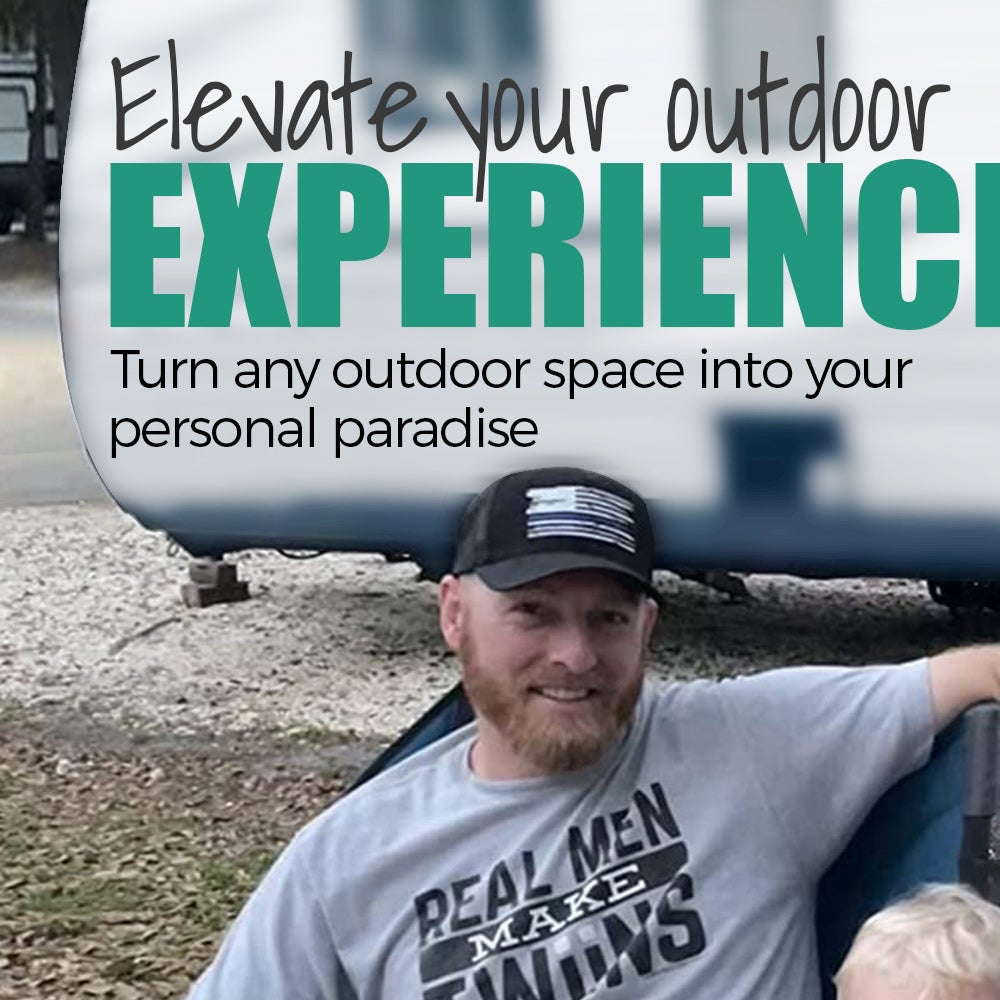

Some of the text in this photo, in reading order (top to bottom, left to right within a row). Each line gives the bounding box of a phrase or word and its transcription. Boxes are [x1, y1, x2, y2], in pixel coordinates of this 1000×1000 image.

[414, 782, 681, 947] REAL MEN
[467, 863, 646, 962] MAKE
